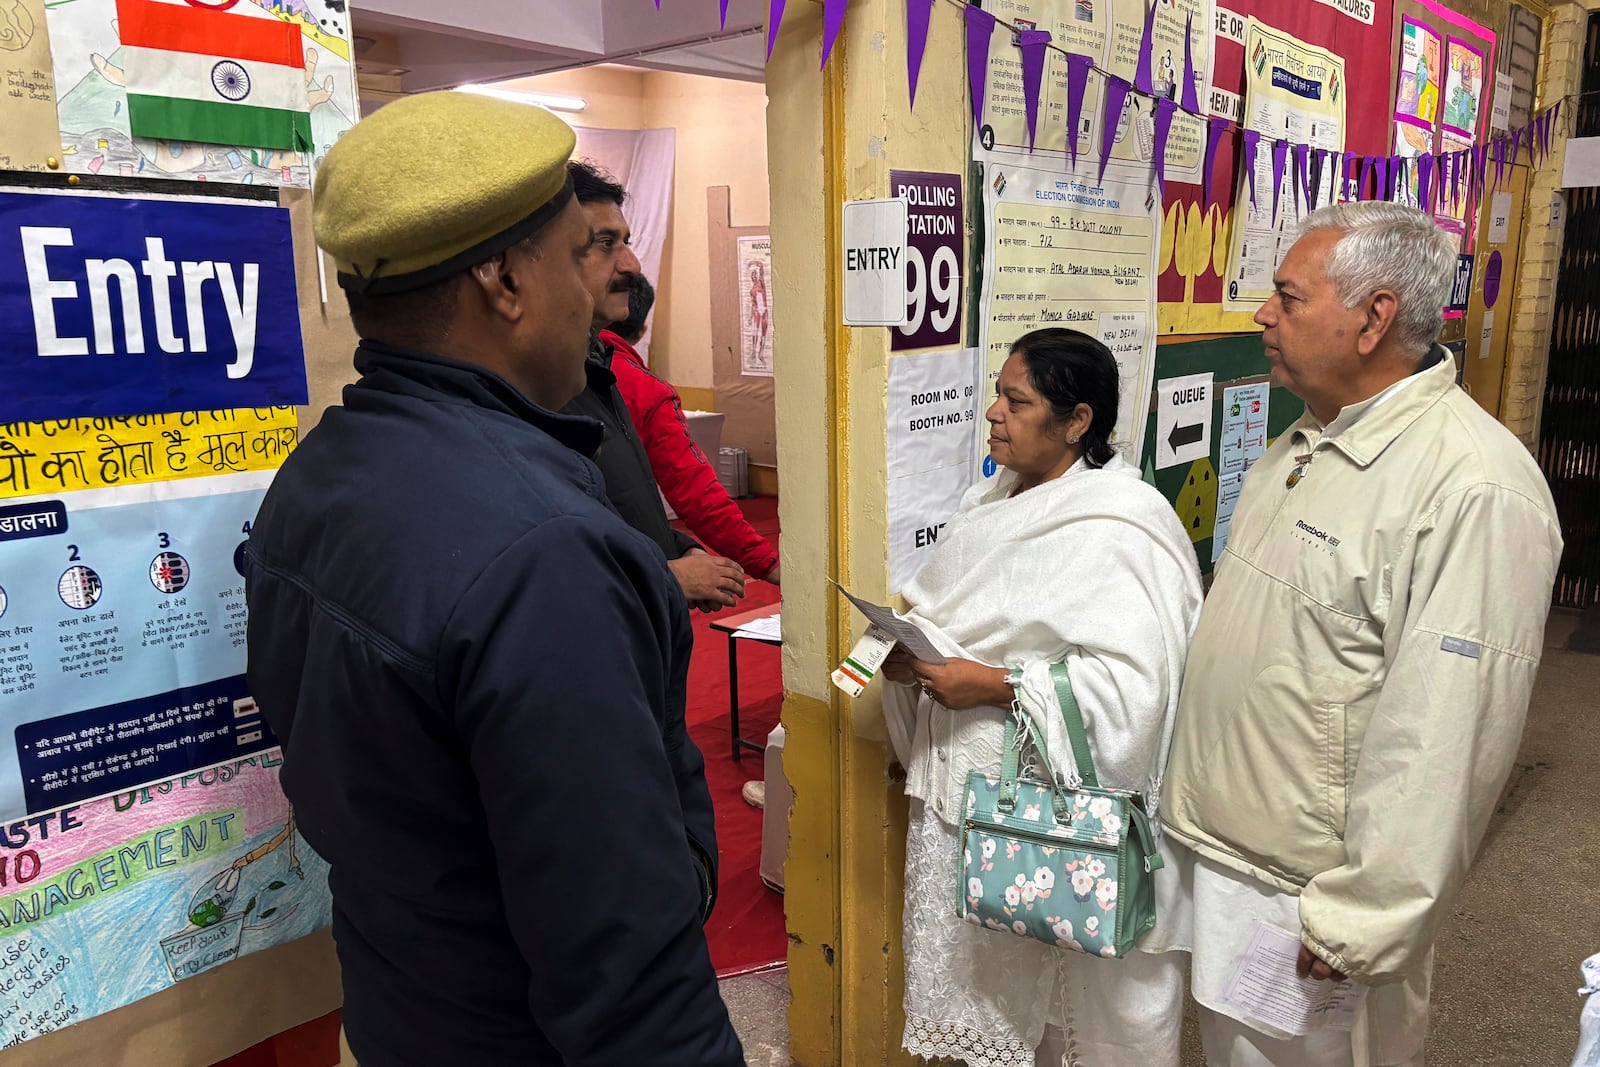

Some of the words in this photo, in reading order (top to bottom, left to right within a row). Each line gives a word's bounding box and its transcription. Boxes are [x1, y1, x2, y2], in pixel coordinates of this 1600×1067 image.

[1230, 18, 1243, 39] OR
[1307, 62, 1326, 80] आयोग
[982, 130, 991, 148] 4
[898, 184, 956, 207] POLLING
[1036, 190, 1066, 202] ELECTION
[1067, 193, 1097, 207] COMMISSION
[1097, 198, 1106, 208] OF
[1106, 199, 1120, 209] INDIA
[1050, 215, 1060, 229] 99
[1040, 234, 1053, 247] 712
[847, 247, 900, 271] ENTRY
[898, 245, 960, 336] 99
[1230, 283, 1237, 298] 2
[20, 226, 259, 379] Entry
[1119, 329, 1138, 339] DELHI
[911, 391, 941, 406] ROOM
[943, 388, 960, 401] NO.
[1173, 386, 1205, 405] QUEUE
[910, 415, 944, 431] BOOTH
[946, 413, 963, 425] NO.
[964, 409, 974, 421] 99
[41, 450, 90, 487] का
[97, 434, 154, 484] होता
[161, 430, 190, 472] है
[197, 430, 248, 472] मूल
[915, 522, 947, 548] EN
[1296, 519, 1328, 541] Reebok
[158, 532, 170, 548] 3
[67, 544, 81, 562] 2
[82, 614, 96, 623] वोट
[36, 738, 50, 748] यदि
[53, 732, 77, 744] आपको
[118, 718, 140, 730] मतदान
[37, 746, 61, 758] आवाज
[73, 739, 93, 751] सुनाई
[105, 732, 114, 742] तो
[147, 718, 174, 732] अधिकारी
[42, 771, 58, 782] शीशे
[71, 765, 78, 774] से
[131, 750, 138, 758] के
[141, 746, 154, 756] लिए
[157, 739, 178, 752] दिखाई
[108, 765, 120, 773] रख
